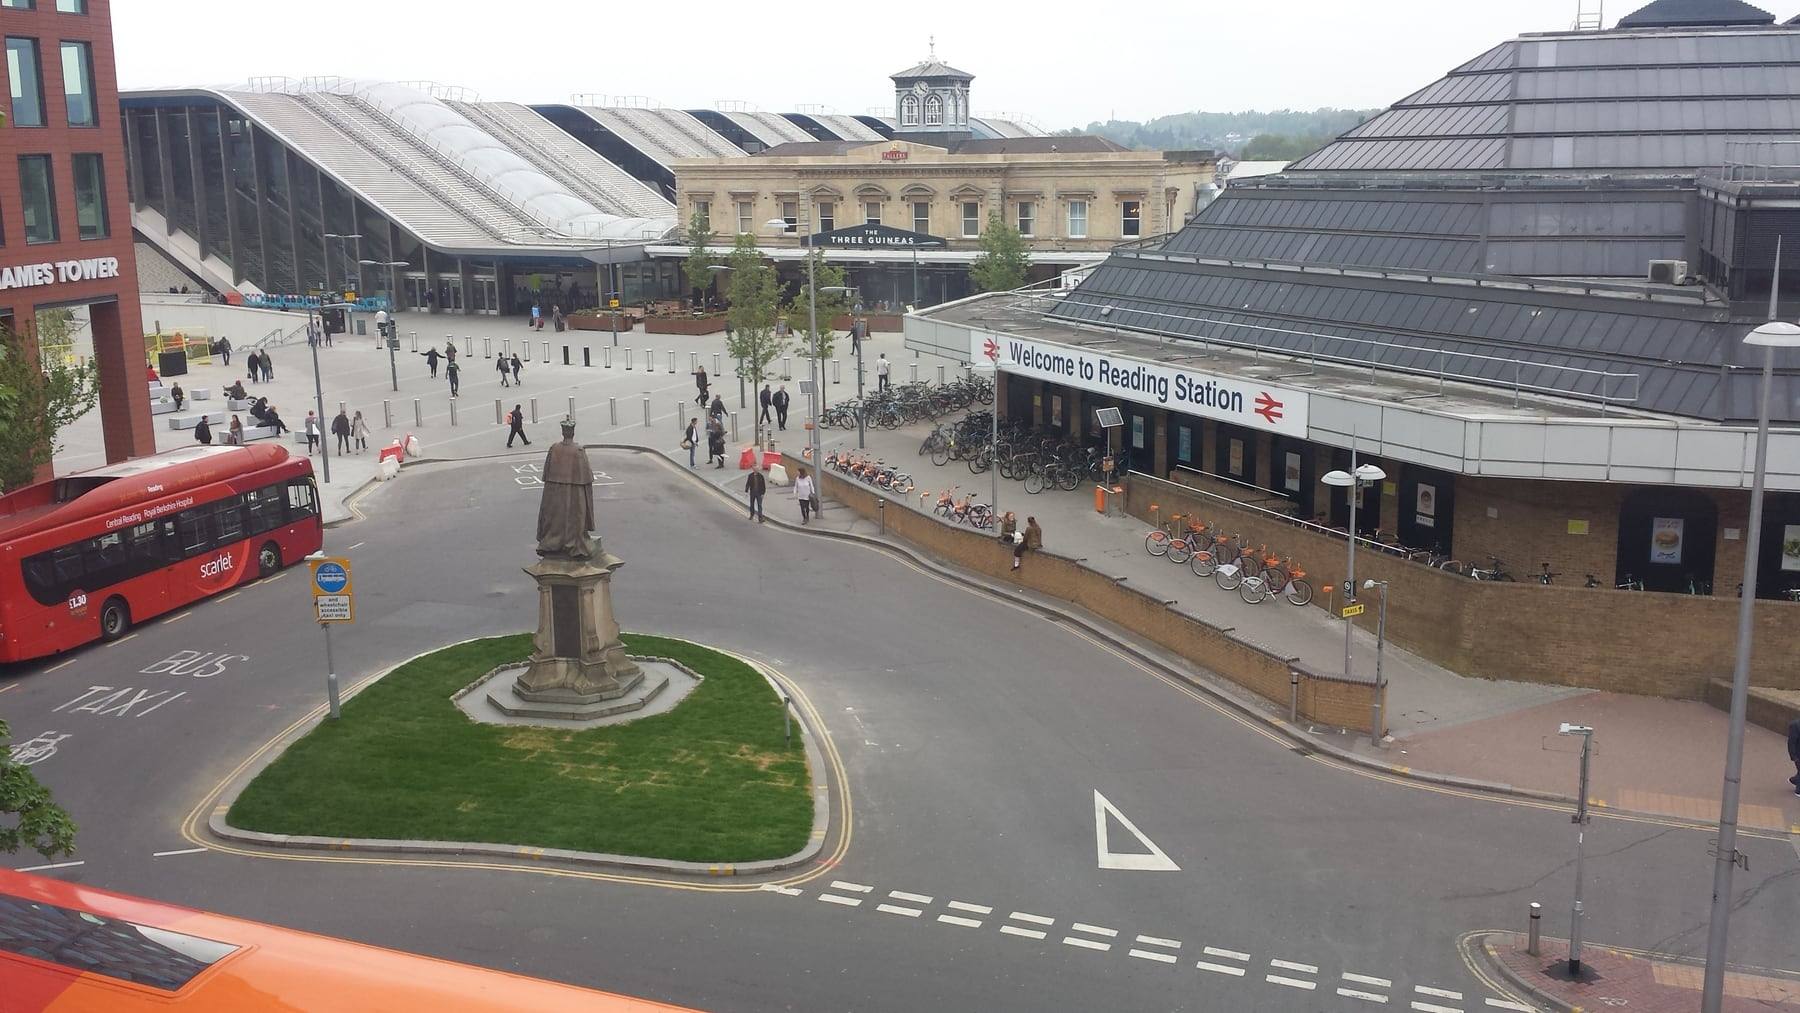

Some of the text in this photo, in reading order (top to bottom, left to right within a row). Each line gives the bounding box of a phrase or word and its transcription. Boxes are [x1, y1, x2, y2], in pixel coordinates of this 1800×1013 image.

[831, 236, 914, 244] THREE GUINEAS
[0, 257, 119, 289] AMES TOWER
[1009, 341, 1243, 413] Welcome to Reading Station
[105, 496, 194, 529] Central Reading Royal Berkshire Hospital
[200, 552, 233, 579] scarlet
[139, 650, 249, 678] BUS
[52, 685, 187, 718] TAXI
